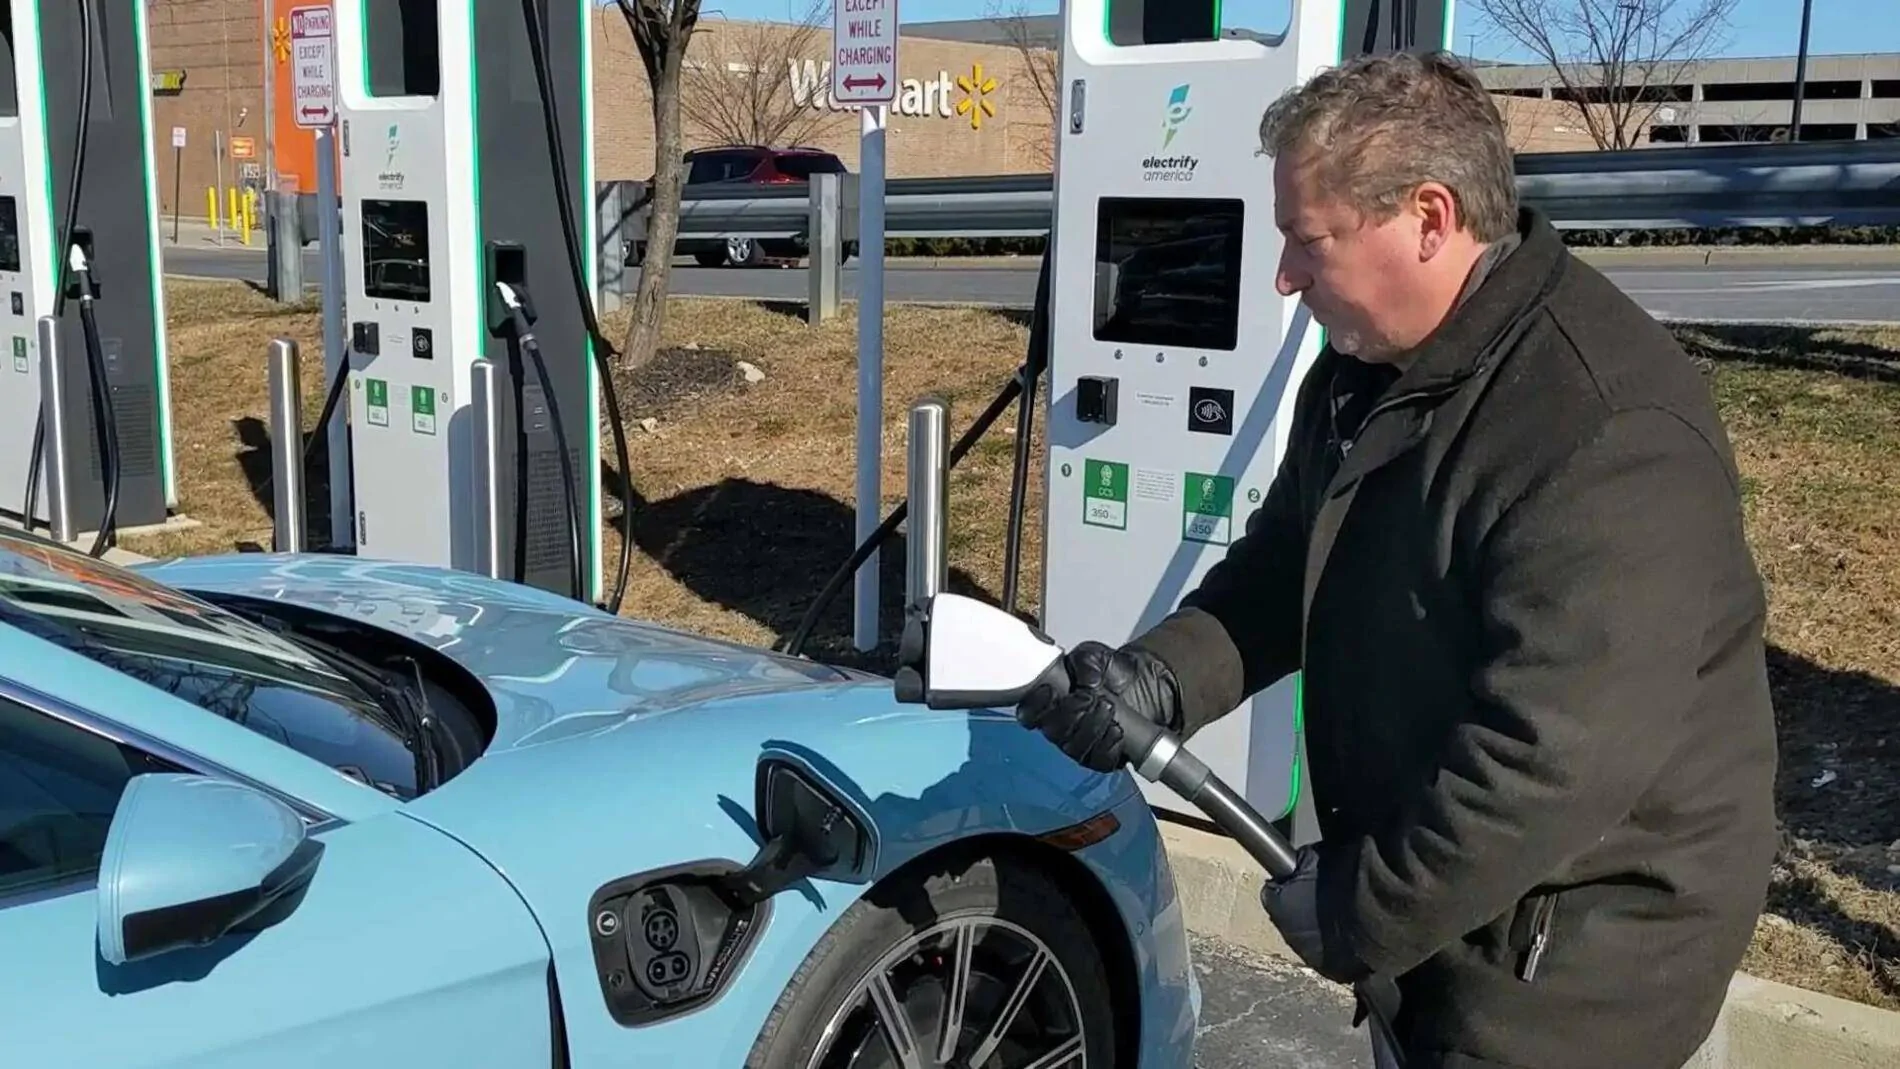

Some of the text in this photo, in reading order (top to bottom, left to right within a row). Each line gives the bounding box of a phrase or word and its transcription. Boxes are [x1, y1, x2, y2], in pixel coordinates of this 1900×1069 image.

[845, 0, 887, 12] EXCEPT
[304, 15, 329, 31] PARKING
[848, 19, 881, 38] WHILE
[299, 44, 325, 60] EXCEPT
[839, 46, 891, 66] CHARGING
[302, 64, 324, 79] WHILE
[298, 84, 331, 99] CHARGING
[787, 57, 953, 119] Wart
[1142, 155, 1198, 171] electrify
[1143, 169, 1194, 182] america
[1091, 507, 1110, 520] 350
[1192, 523, 1212, 536] 350
